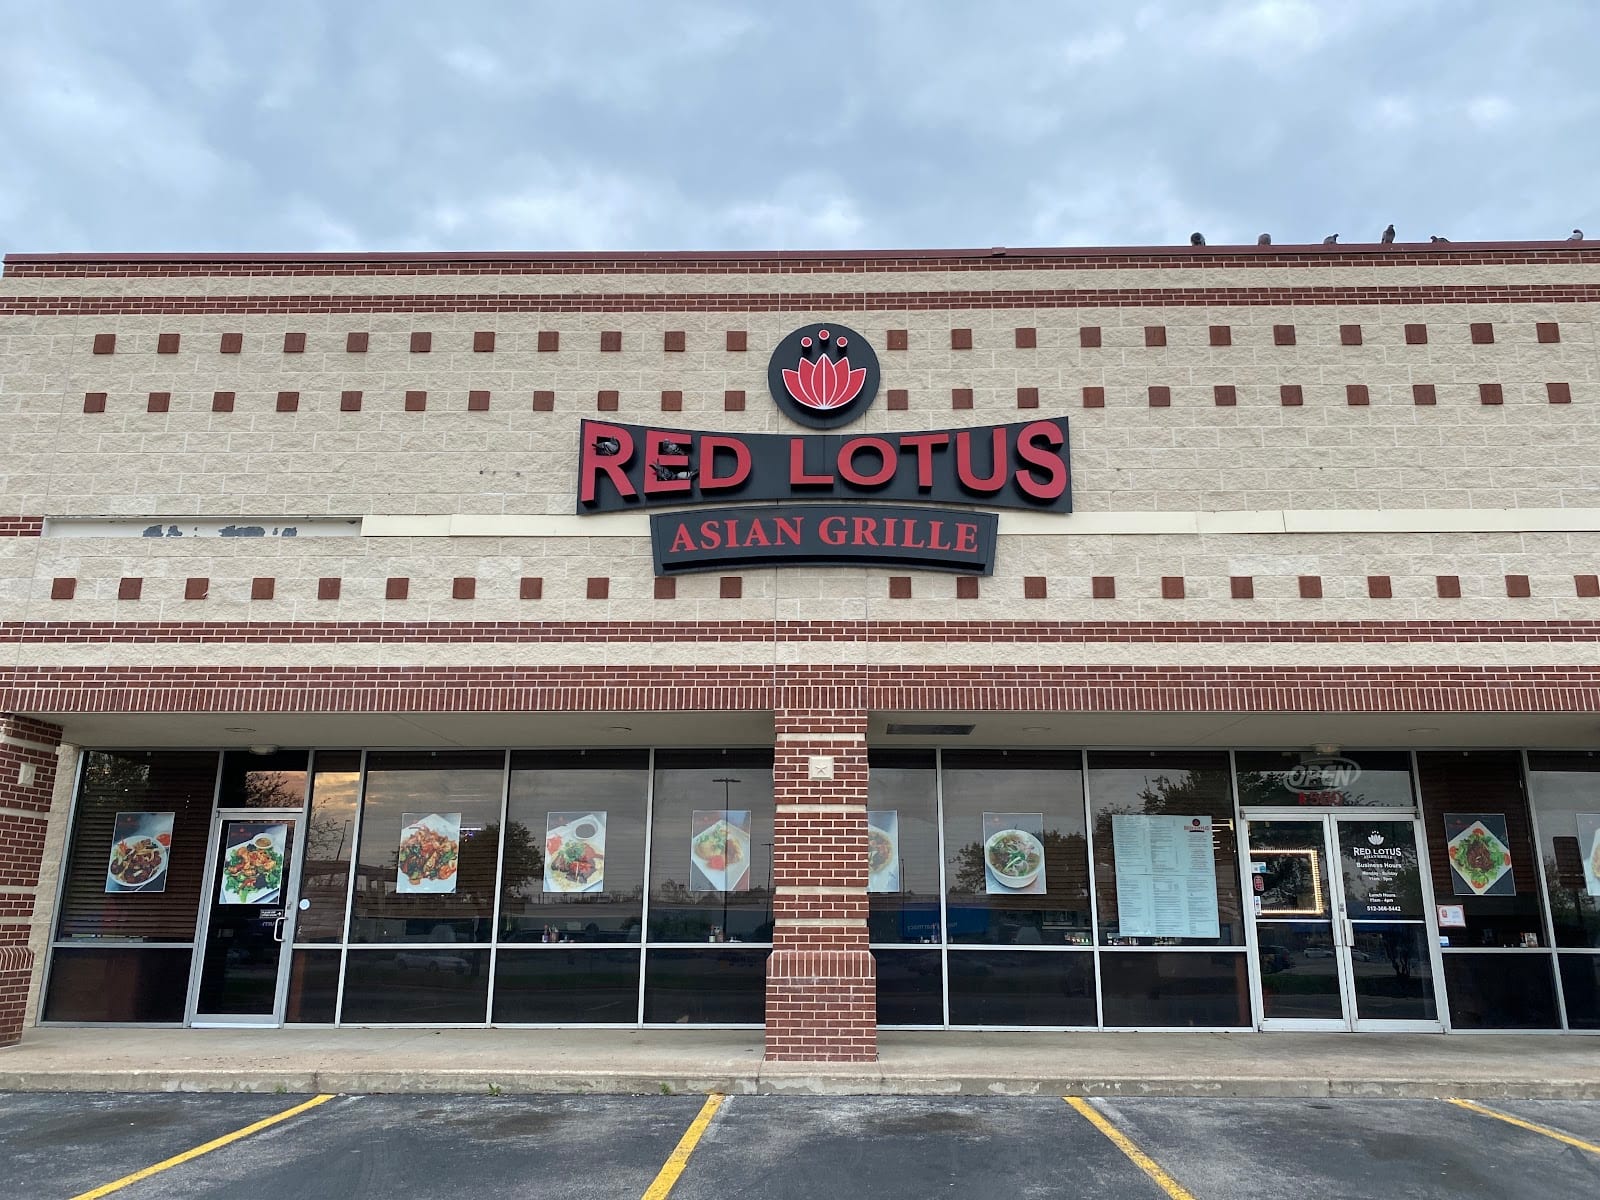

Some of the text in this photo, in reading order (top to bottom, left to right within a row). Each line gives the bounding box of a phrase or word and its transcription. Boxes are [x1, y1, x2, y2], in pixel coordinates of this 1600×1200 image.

[581, 419, 1068, 501] RED LOTUS
[670, 516, 978, 553] ASIAN GRILLE
[1289, 765, 1352, 786] OPEN
[1353, 847, 1401, 856] RED LOTUS
